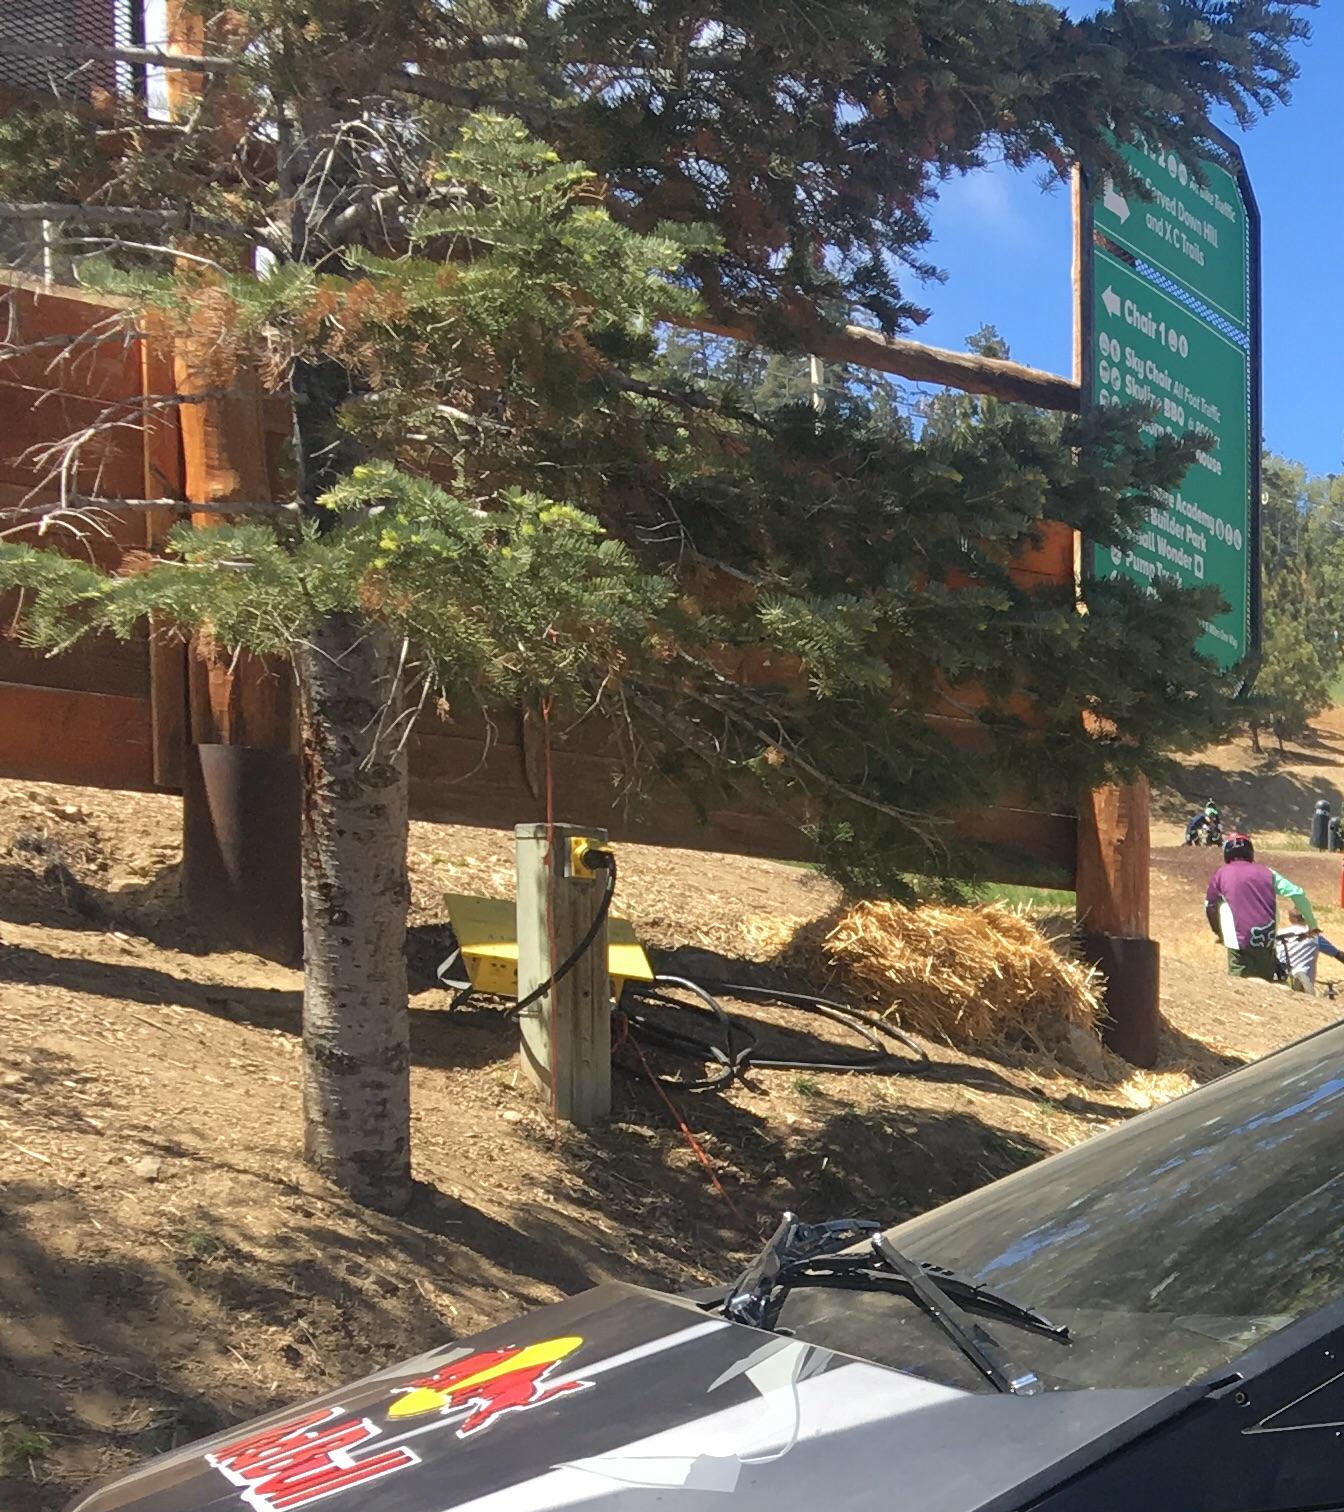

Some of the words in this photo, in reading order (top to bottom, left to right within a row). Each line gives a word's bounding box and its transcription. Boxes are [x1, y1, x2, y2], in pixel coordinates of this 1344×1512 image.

[1145, 212, 1165, 238] and
[1180, 232, 1205, 267] Trails
[1177, 201, 1203, 236] Down
[1203, 220, 1219, 249] Hill
[1124, 299, 1158, 340] Chair
[1158, 321, 1166, 346] 1
[1125, 346, 1145, 380] Sky
[1145, 359, 1173, 392] Chair
[1183, 386, 1201, 411] Foot
[1200, 397, 1221, 424] Traffic
[1150, 507, 1185, 541] Builder
[1185, 523, 1207, 553] Park
[1175, 492, 1216, 536] Academy
[1125, 549, 1156, 583] Pump
[1156, 534, 1193, 571] Wonder
